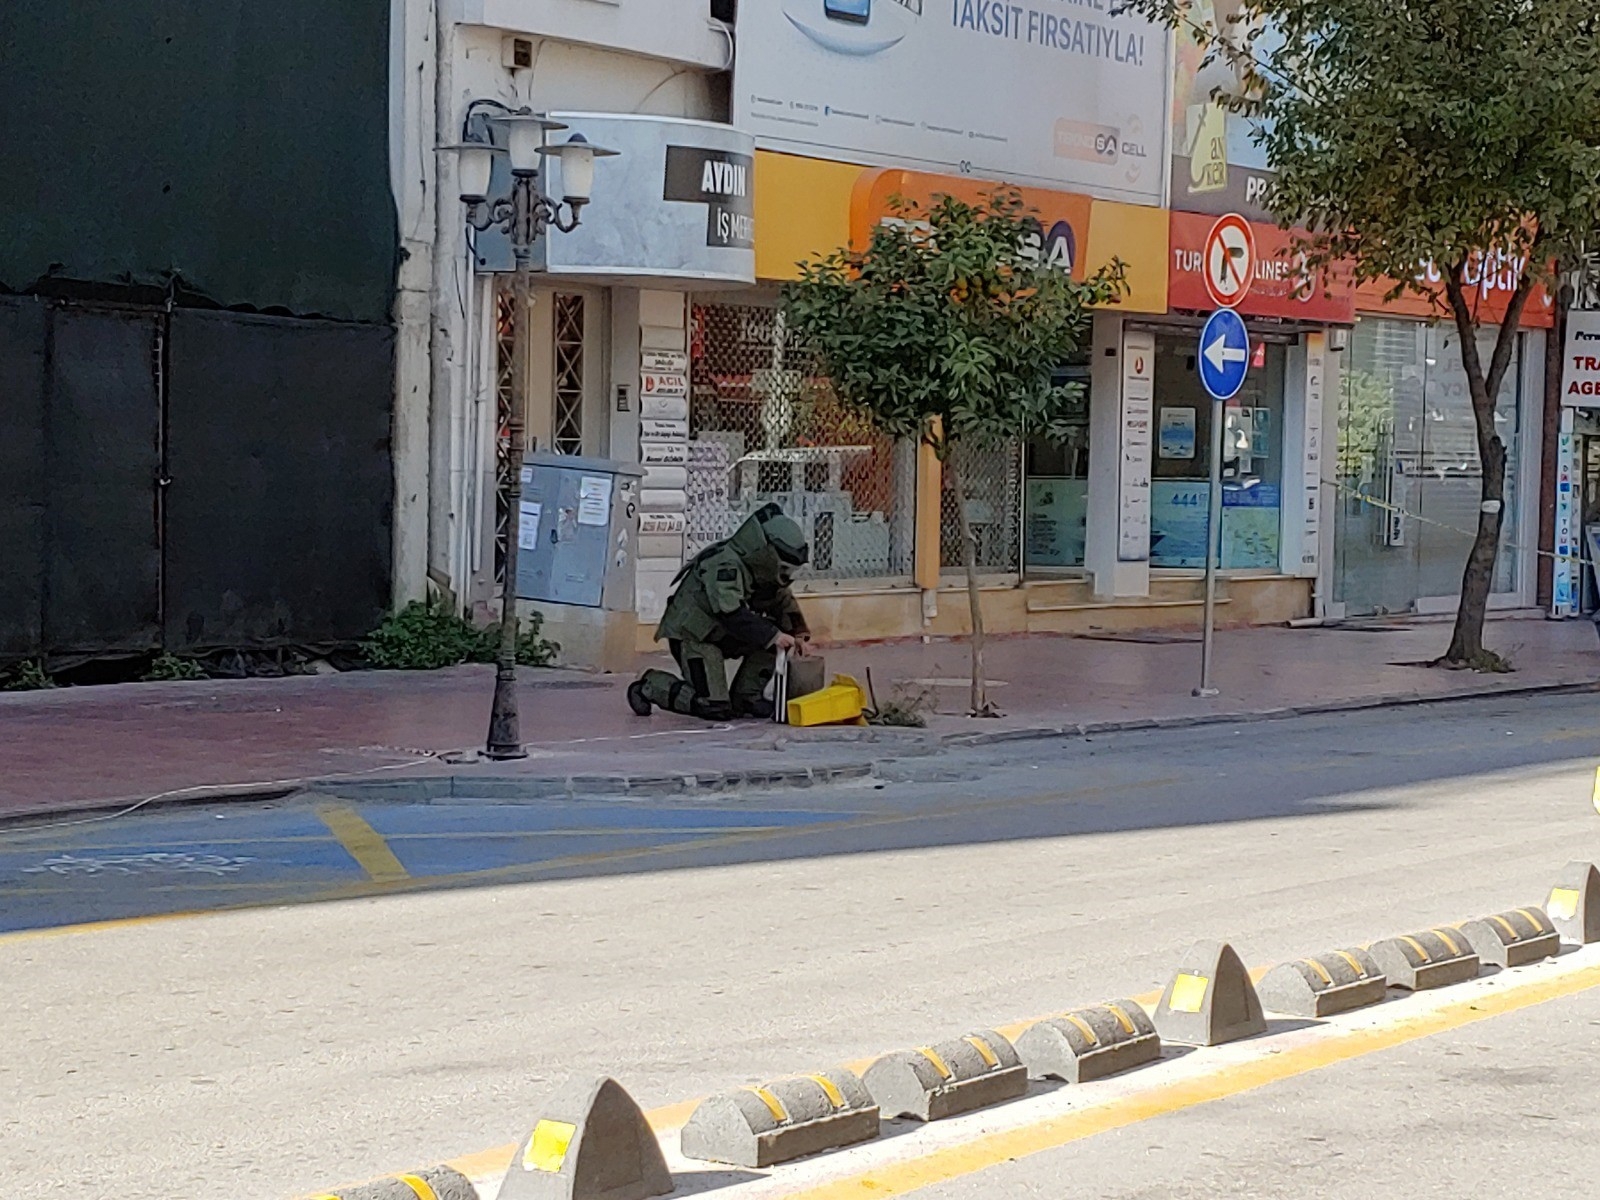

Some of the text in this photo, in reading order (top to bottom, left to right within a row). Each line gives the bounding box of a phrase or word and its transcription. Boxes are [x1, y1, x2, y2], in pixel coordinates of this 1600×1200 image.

[1027, 10, 1145, 66] FIRSATIYLA!
[1121, 142, 1147, 157] CELL
[701, 161, 746, 197] AYDIN
[717, 207, 729, 243] İŞ
